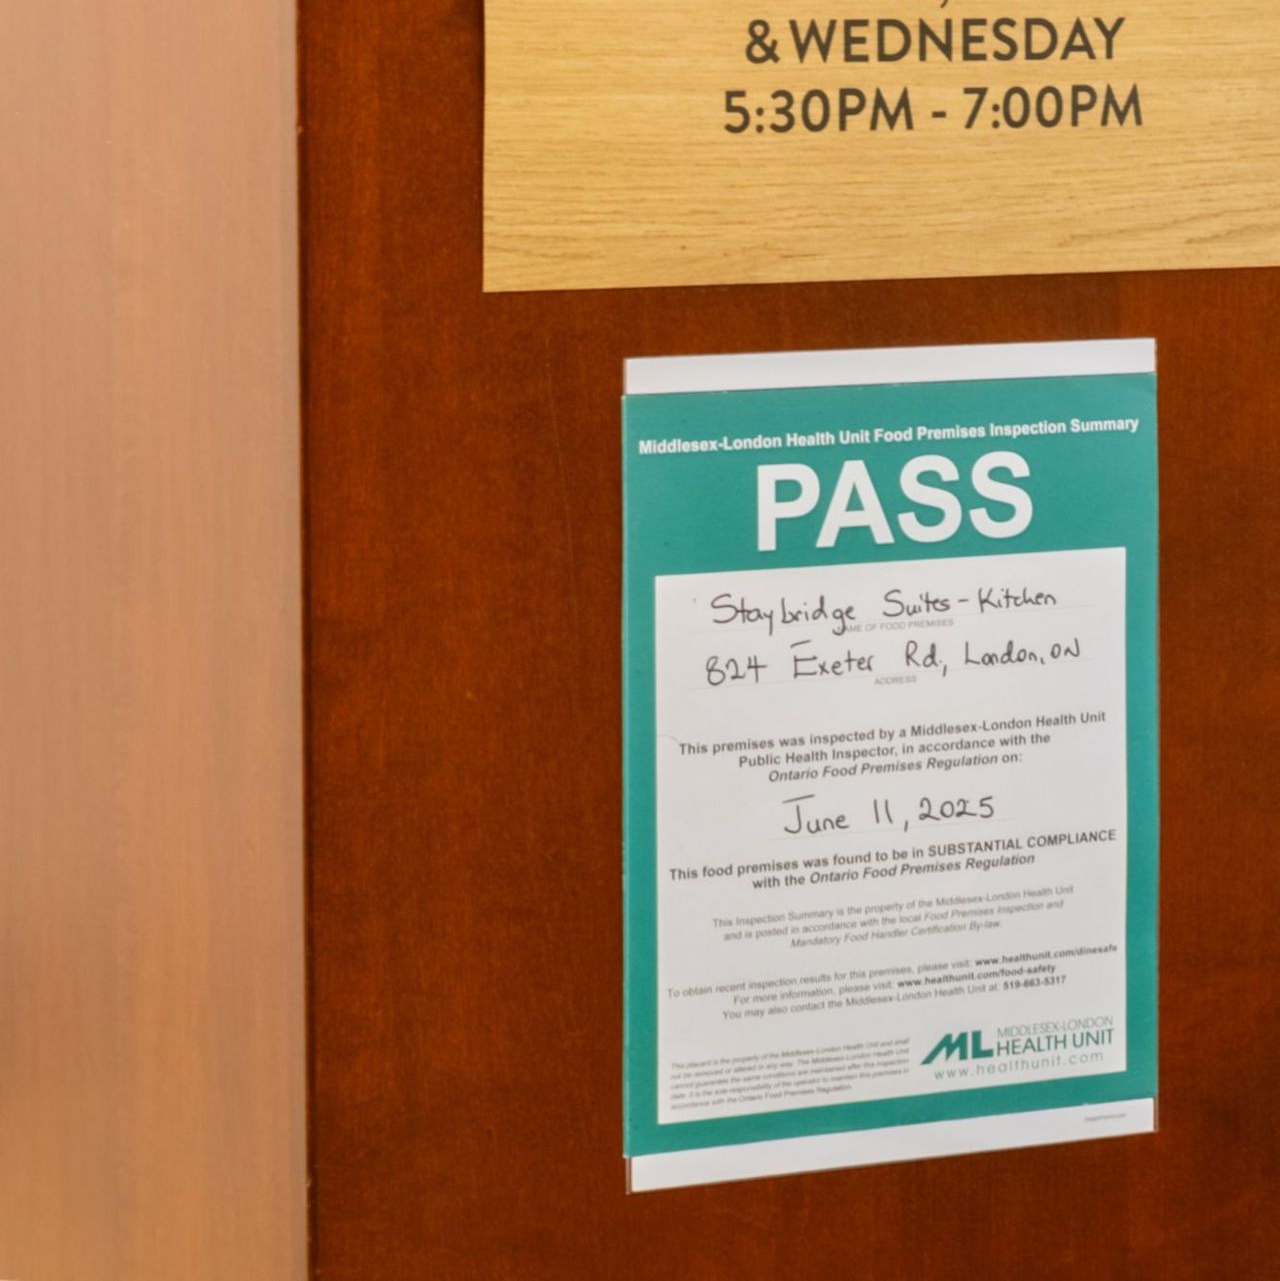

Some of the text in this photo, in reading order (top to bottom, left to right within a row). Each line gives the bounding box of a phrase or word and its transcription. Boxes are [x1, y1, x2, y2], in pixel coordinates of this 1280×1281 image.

[723, 83, 1143, 135] 5:30PM - 7:00PM
[638, 418, 1140, 456] Middlesex-London Health Unit Food Premises Inspection Summary
[756, 450, 1034, 552] PASS
[711, 593, 856, 636] Staybridge
[883, 589, 951, 618] Suites
[977, 587, 1057, 613] Kitchen
[706, 655, 768, 686] 824
[790, 639, 875, 679] Exeter
[964, 640, 1045, 667] London,
[678, 710, 1107, 756] This premises was inspected by a Middlesex-London Health Unit
[738, 753, 782, 769] Public
[784, 748, 829, 765] Health
[901, 743, 915, 755] in
[917, 737, 997, 754] accordance
[998, 733, 1028, 748] with
[1029, 732, 1052, 746] the
[767, 752, 1022, 784] Ontario Food Premises Regulation on:
[782, 794, 850, 834] June
[918, 796, 995, 822] 2025
[668, 828, 1116, 881] This food premises was found to be in SUBSTANTIAL COMPLIANCE
[751, 853, 1036, 890] with the Ontario Food Premises Regulation
[996, 1015, 1115, 1040] MIDDLESEX-LONDON
[996, 1027, 1114, 1058] HEALTH UNIT
[920, 1030, 995, 1066] ML
[933, 1051, 1104, 1081] www.healthunit.com
